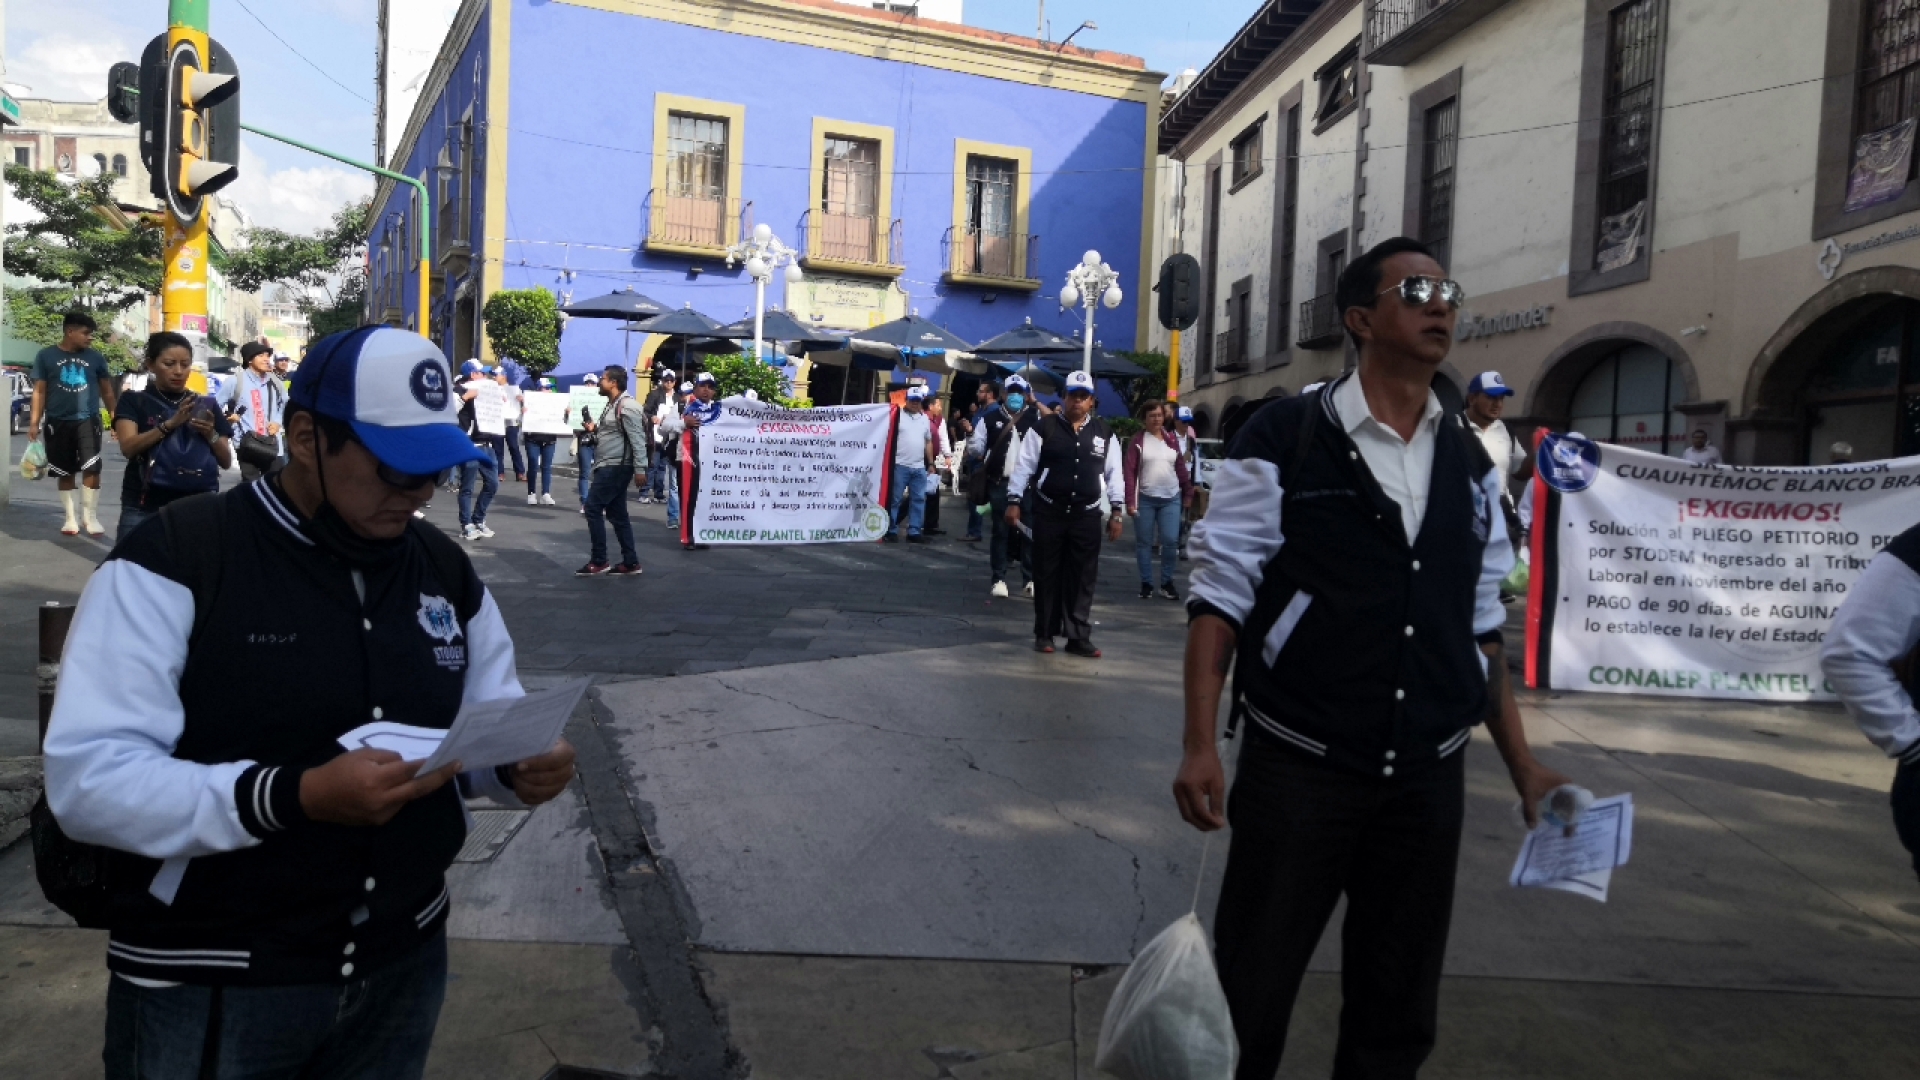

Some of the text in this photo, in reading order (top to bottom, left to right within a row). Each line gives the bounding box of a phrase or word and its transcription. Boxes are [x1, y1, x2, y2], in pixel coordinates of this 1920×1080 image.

[1473, 303, 1553, 338] Santander
[839, 413, 872, 422] BRAVO
[757, 423, 832, 436] ¡EXIGIMOS!
[760, 436, 787, 445] Laboral
[840, 440, 868, 449] URGENTE
[713, 446, 748, 456] Docentes
[755, 448, 800, 458] Orientadores
[713, 460, 731, 470] Pago
[739, 461, 775, 470] Inmediato
[783, 464, 791, 472] de
[712, 473, 741, 482] docente
[1617, 464, 1920, 492] CUAUHTÉMOC BLANCO BRA
[710, 488, 732, 496] Bono
[759, 489, 770, 497] día
[779, 490, 790, 498] del
[709, 501, 756, 510] puntualidad
[772, 502, 800, 511] descarga
[1677, 498, 1842, 522] ¡EXIGIMOS!
[699, 526, 860, 541] CONALEP PLANTEL TEPOZTLÁN
[1588, 519, 1659, 539] Solución
[1669, 526, 1682, 540] al
[1692, 527, 1752, 543] PLIEGO
[1763, 529, 1859, 546] PETITORIO
[1588, 547, 1616, 562] por
[1623, 546, 1696, 563] STODEM
[1702, 552, 1786, 571] Ingresado
[1795, 554, 1810, 568] al
[1588, 569, 1847, 594] Laboral en Noviembre del año
[1586, 595, 1631, 611] PAGO
[1638, 597, 1660, 612] de
[1668, 598, 1689, 613] 90
[1697, 599, 1732, 616] días
[1740, 602, 1761, 617] de
[246, 632, 298, 643] オルランド
[1585, 618, 1600, 632] lo
[1606, 619, 1682, 637] establece
[1688, 623, 1704, 638] la
[1709, 624, 1735, 642] ley
[1740, 626, 1767, 642] del
[1589, 665, 1702, 689] CONALEP
[1710, 668, 1816, 694] PLANTEL
